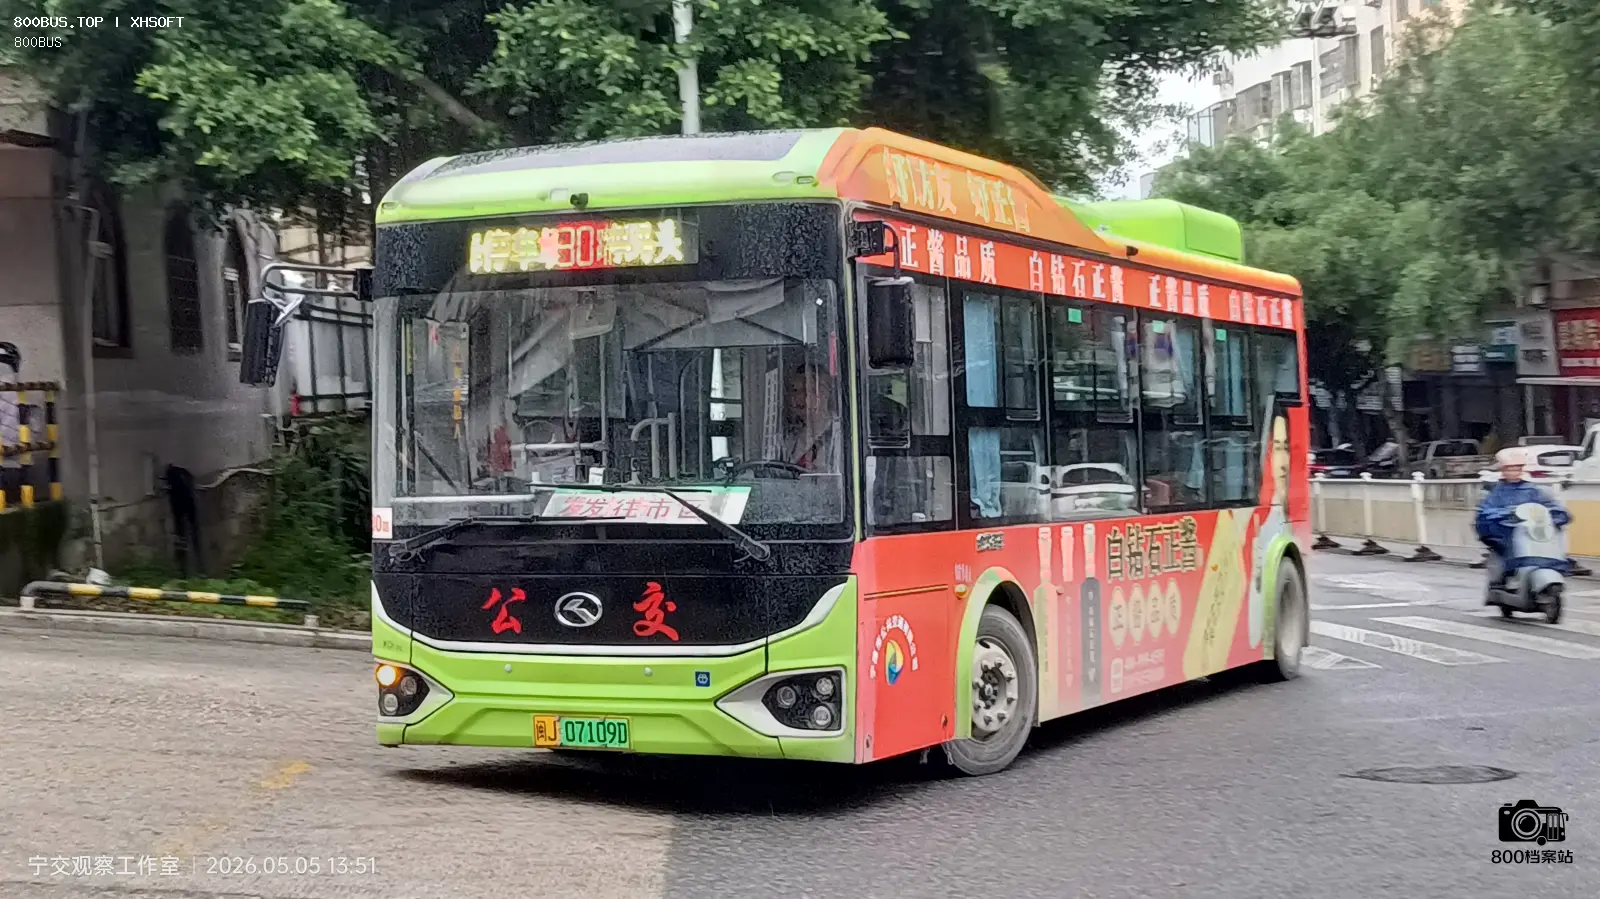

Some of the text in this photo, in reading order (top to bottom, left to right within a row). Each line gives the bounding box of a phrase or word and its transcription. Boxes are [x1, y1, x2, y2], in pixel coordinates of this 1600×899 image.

[1105, 516, 1197, 583] 白钻石正酱
